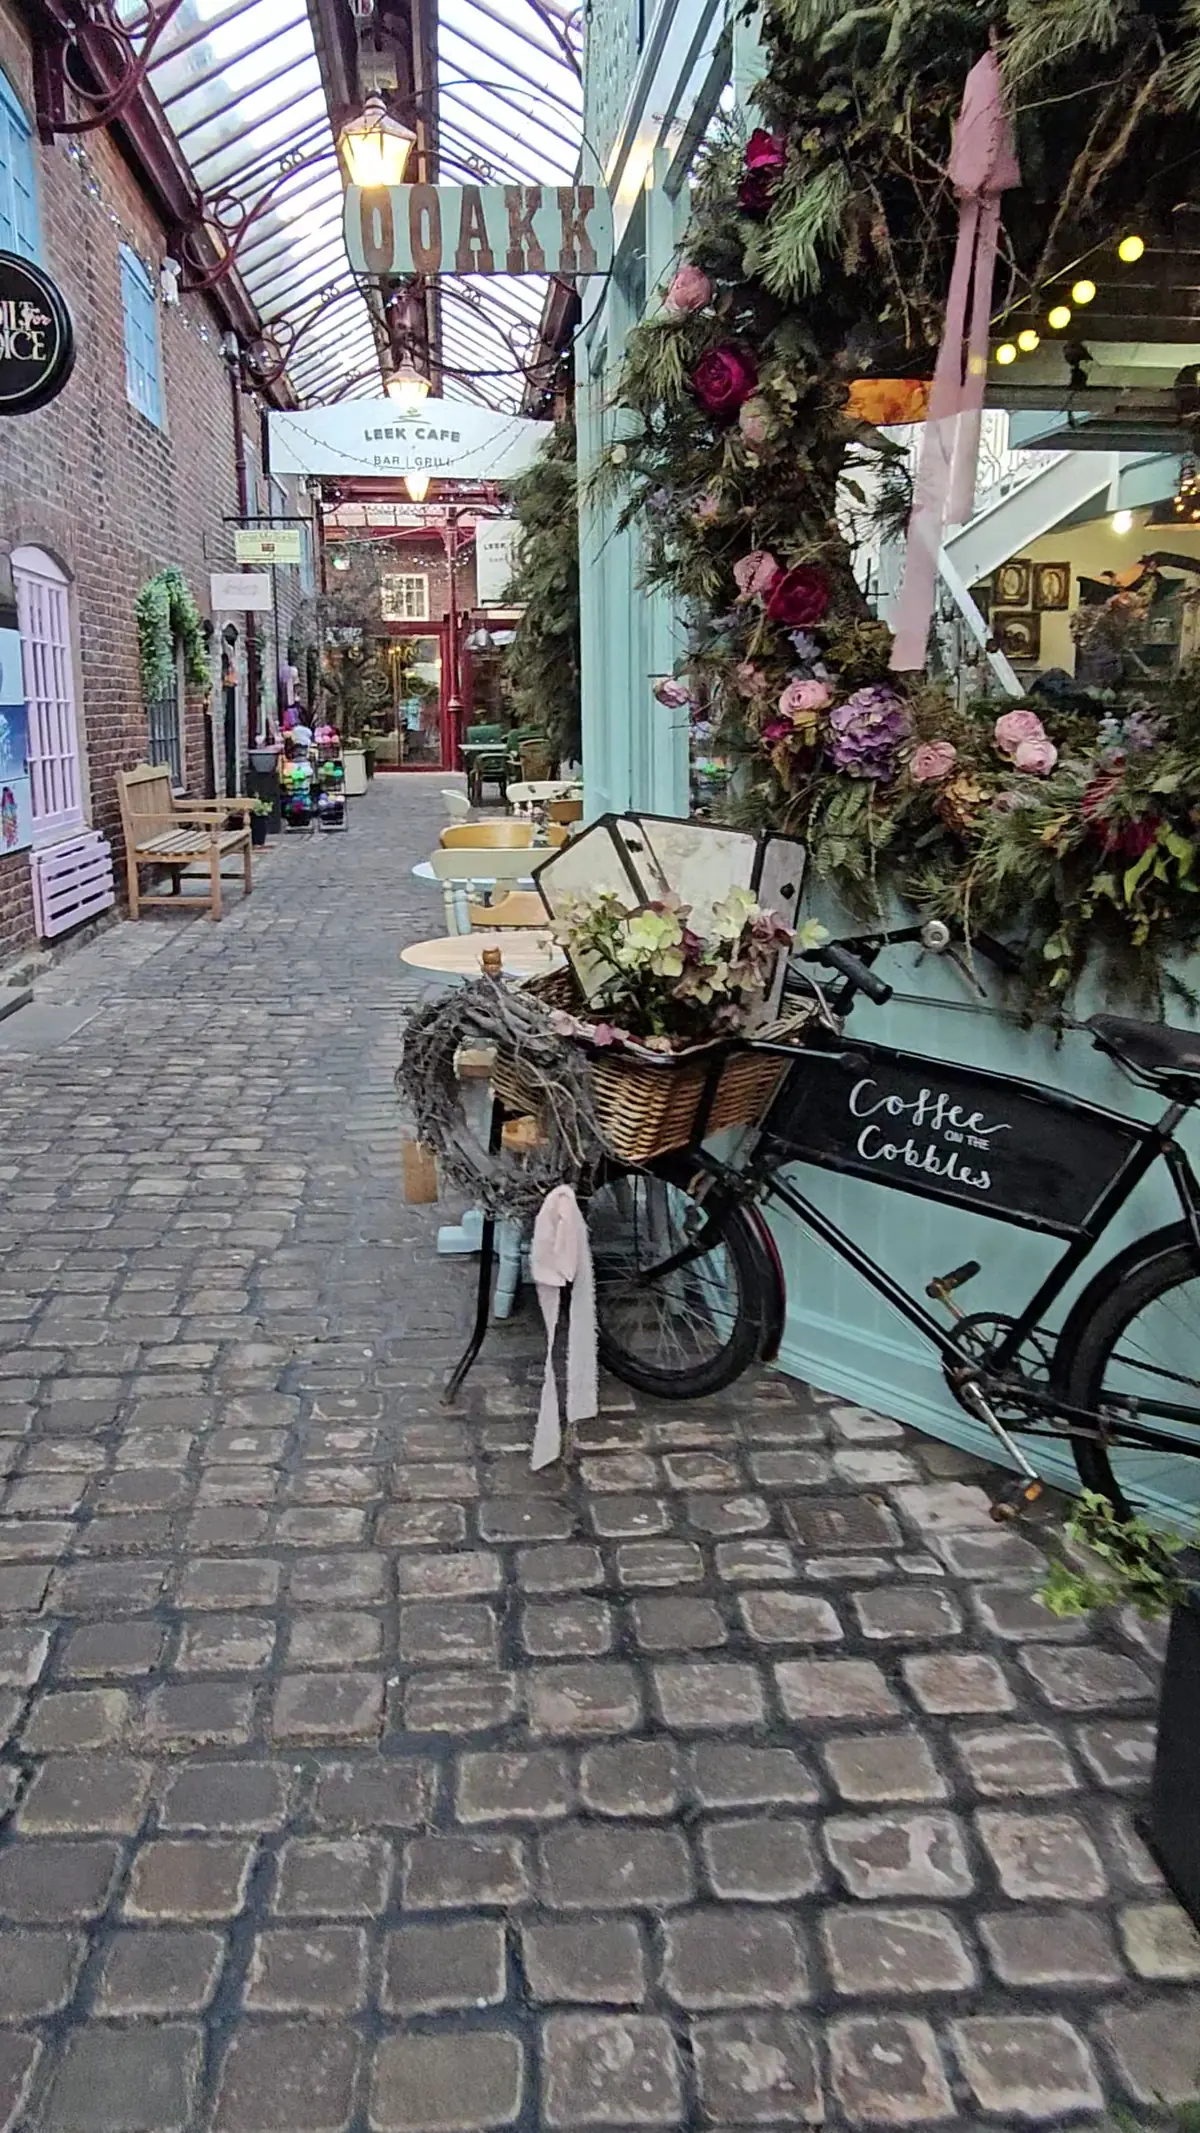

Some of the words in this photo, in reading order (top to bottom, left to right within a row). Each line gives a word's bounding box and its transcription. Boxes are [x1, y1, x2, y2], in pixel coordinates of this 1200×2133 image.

[360, 185, 597, 273] OOAKK
[364, 427, 407, 442] LEEK
[415, 428, 461, 443] CAFE
[373, 455, 400, 466] BAR
[414, 456, 451, 467] GRILL
[849, 1079, 1012, 1134] Coffee
[857, 1125, 991, 1189] Cobbles
[944, 1130, 964, 1144] ON
[967, 1134, 991, 1151] THE
